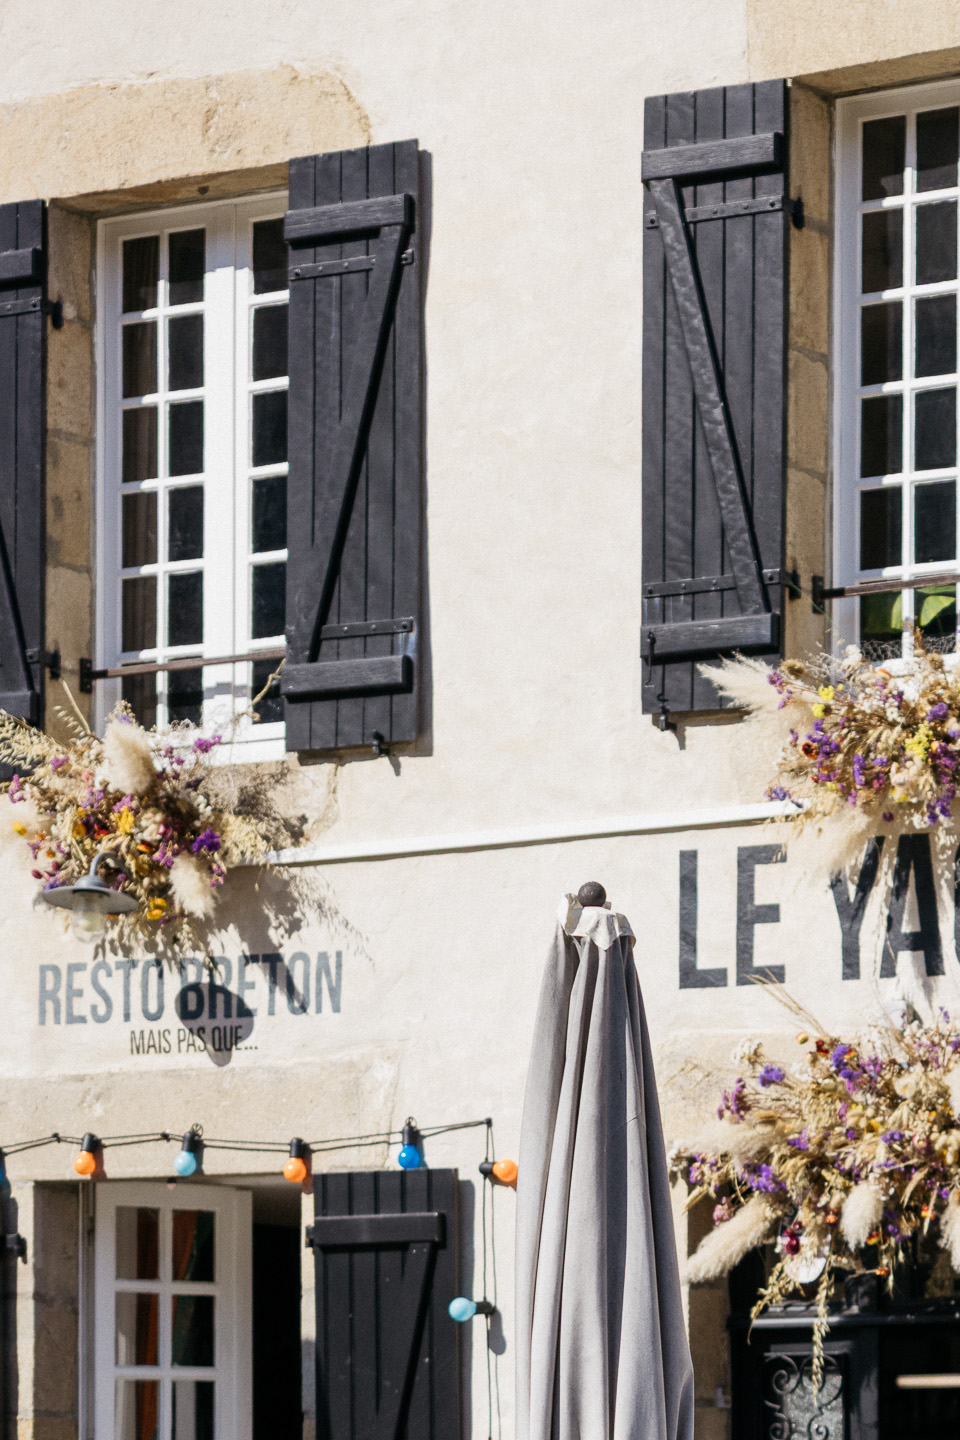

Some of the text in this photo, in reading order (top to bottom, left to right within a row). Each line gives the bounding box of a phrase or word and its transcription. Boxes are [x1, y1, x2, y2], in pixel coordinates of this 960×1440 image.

[679, 844, 787, 989] LE
[38, 950, 343, 1026] RESTO BRETON
[130, 1024, 259, 1056] MAIS PAS QUE...
